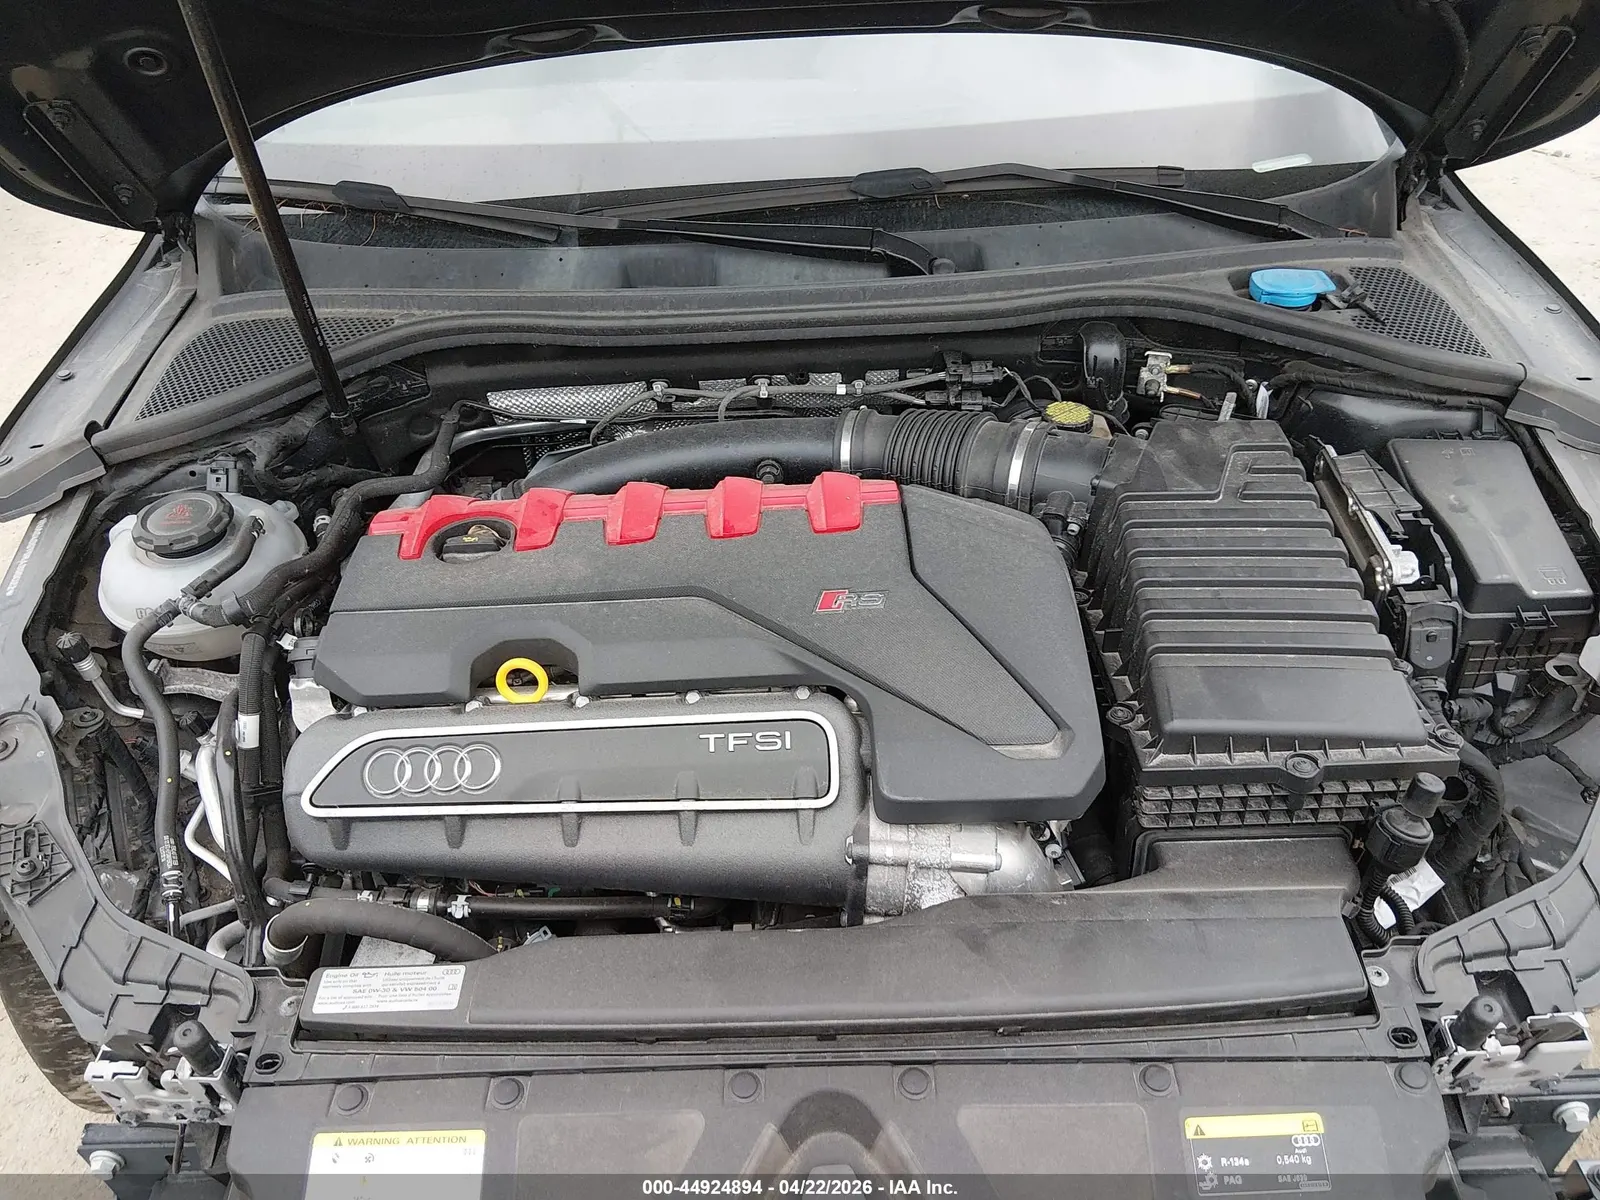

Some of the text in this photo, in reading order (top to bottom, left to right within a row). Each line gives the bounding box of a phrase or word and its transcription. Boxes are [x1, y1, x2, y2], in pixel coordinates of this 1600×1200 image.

[699, 731, 791, 753] TFSI
[347, 1135, 468, 1146] WARNING ATTENTION
[1301, 1154, 1312, 1166] kg
[1223, 1175, 1243, 1185] PAG
